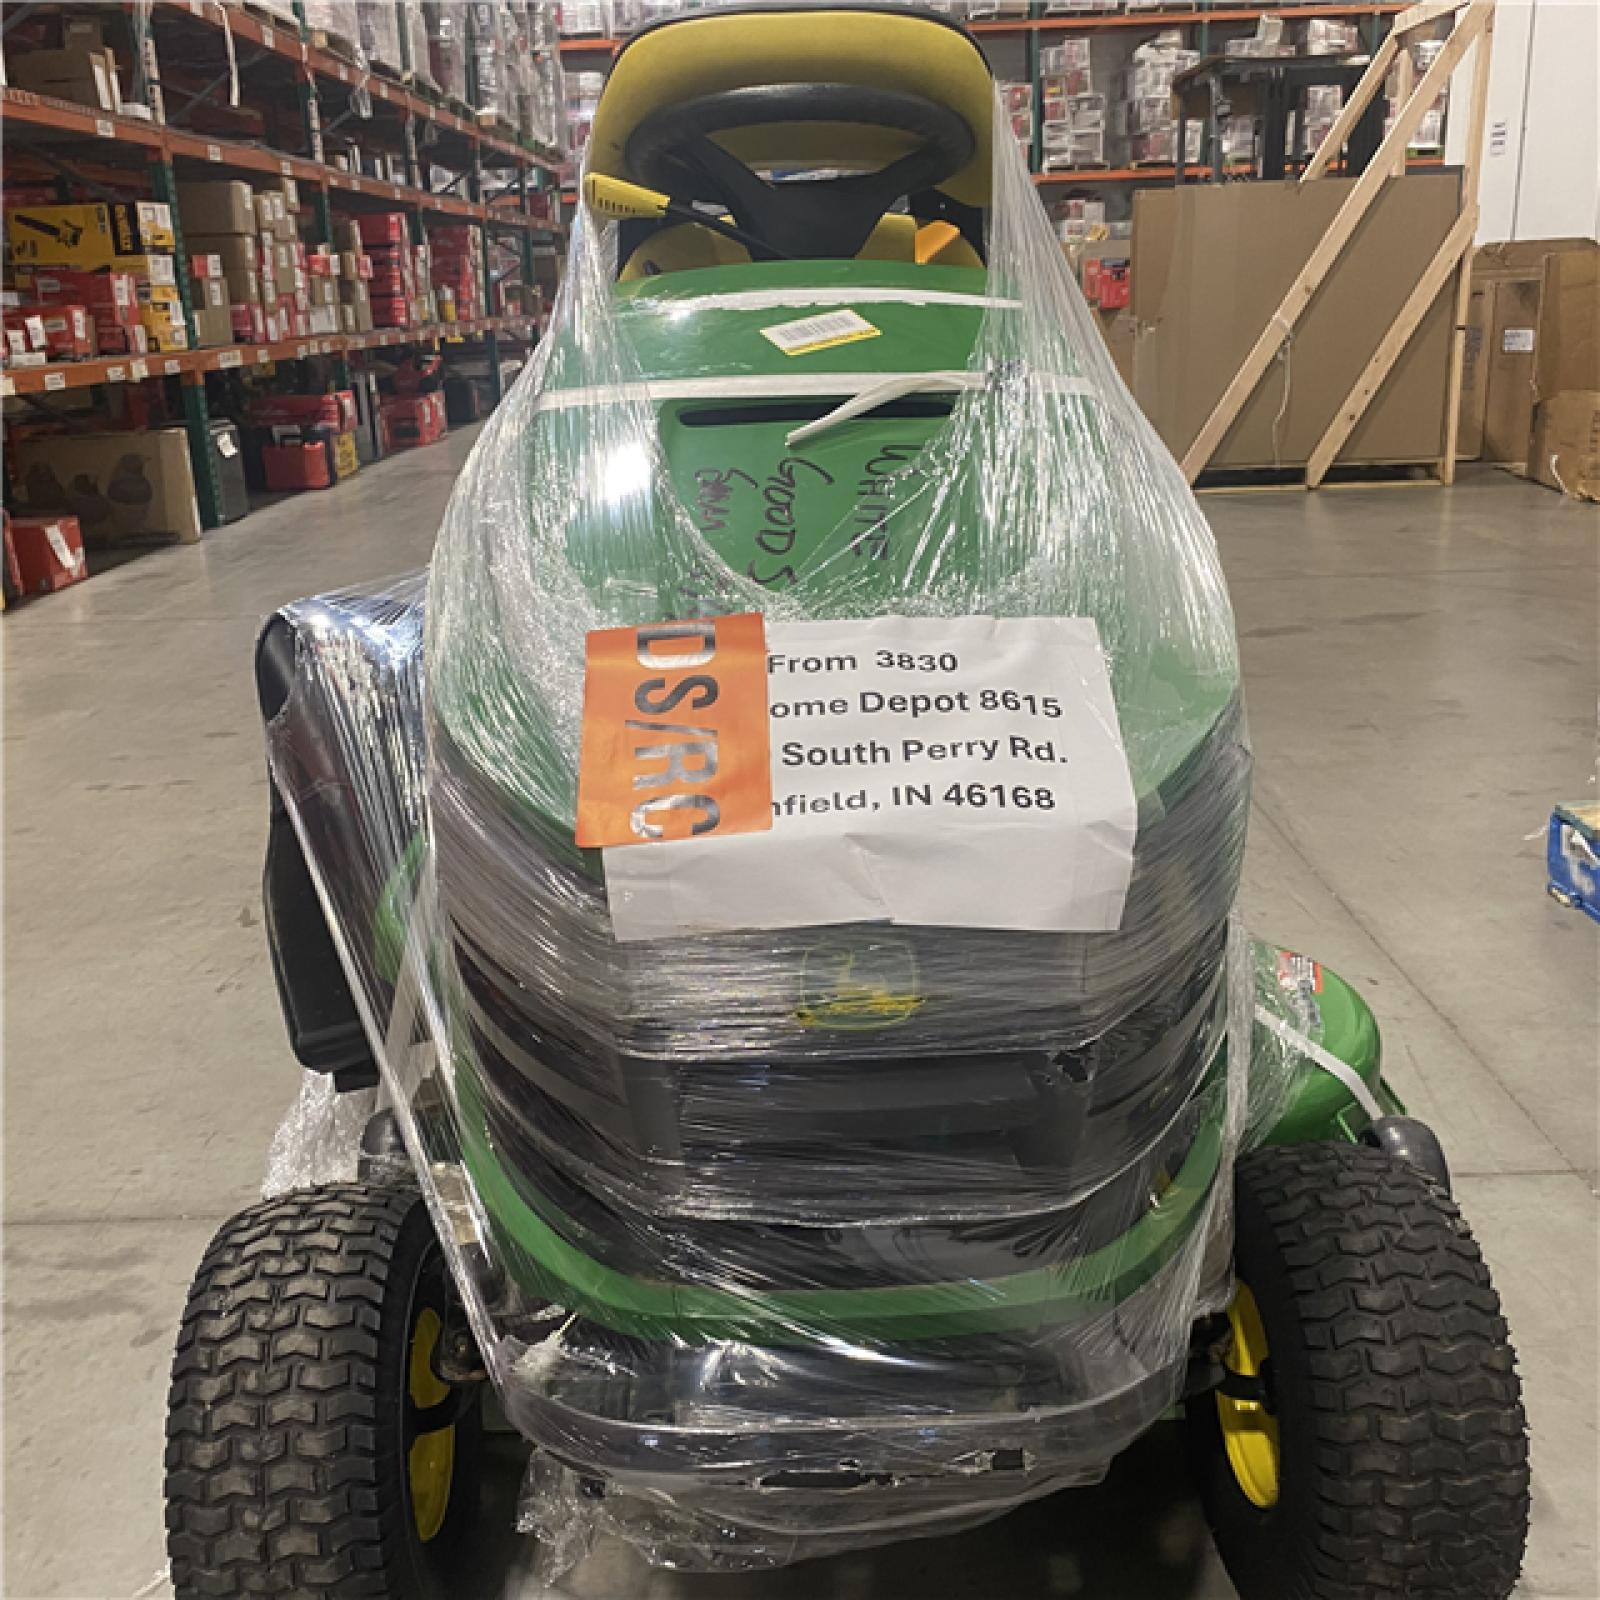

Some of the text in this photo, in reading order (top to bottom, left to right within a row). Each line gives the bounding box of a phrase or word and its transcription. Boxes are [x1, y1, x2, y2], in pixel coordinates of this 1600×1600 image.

[852, 444, 923, 561] WHITE
[767, 649, 958, 673] From 3830
[770, 689, 1063, 718] ome Depot 8615
[624, 623, 721, 838] DS/RC
[782, 735, 1068, 766] South Perry Rd.
[892, 784, 931, 806] IN
[943, 782, 1056, 810] 46168
